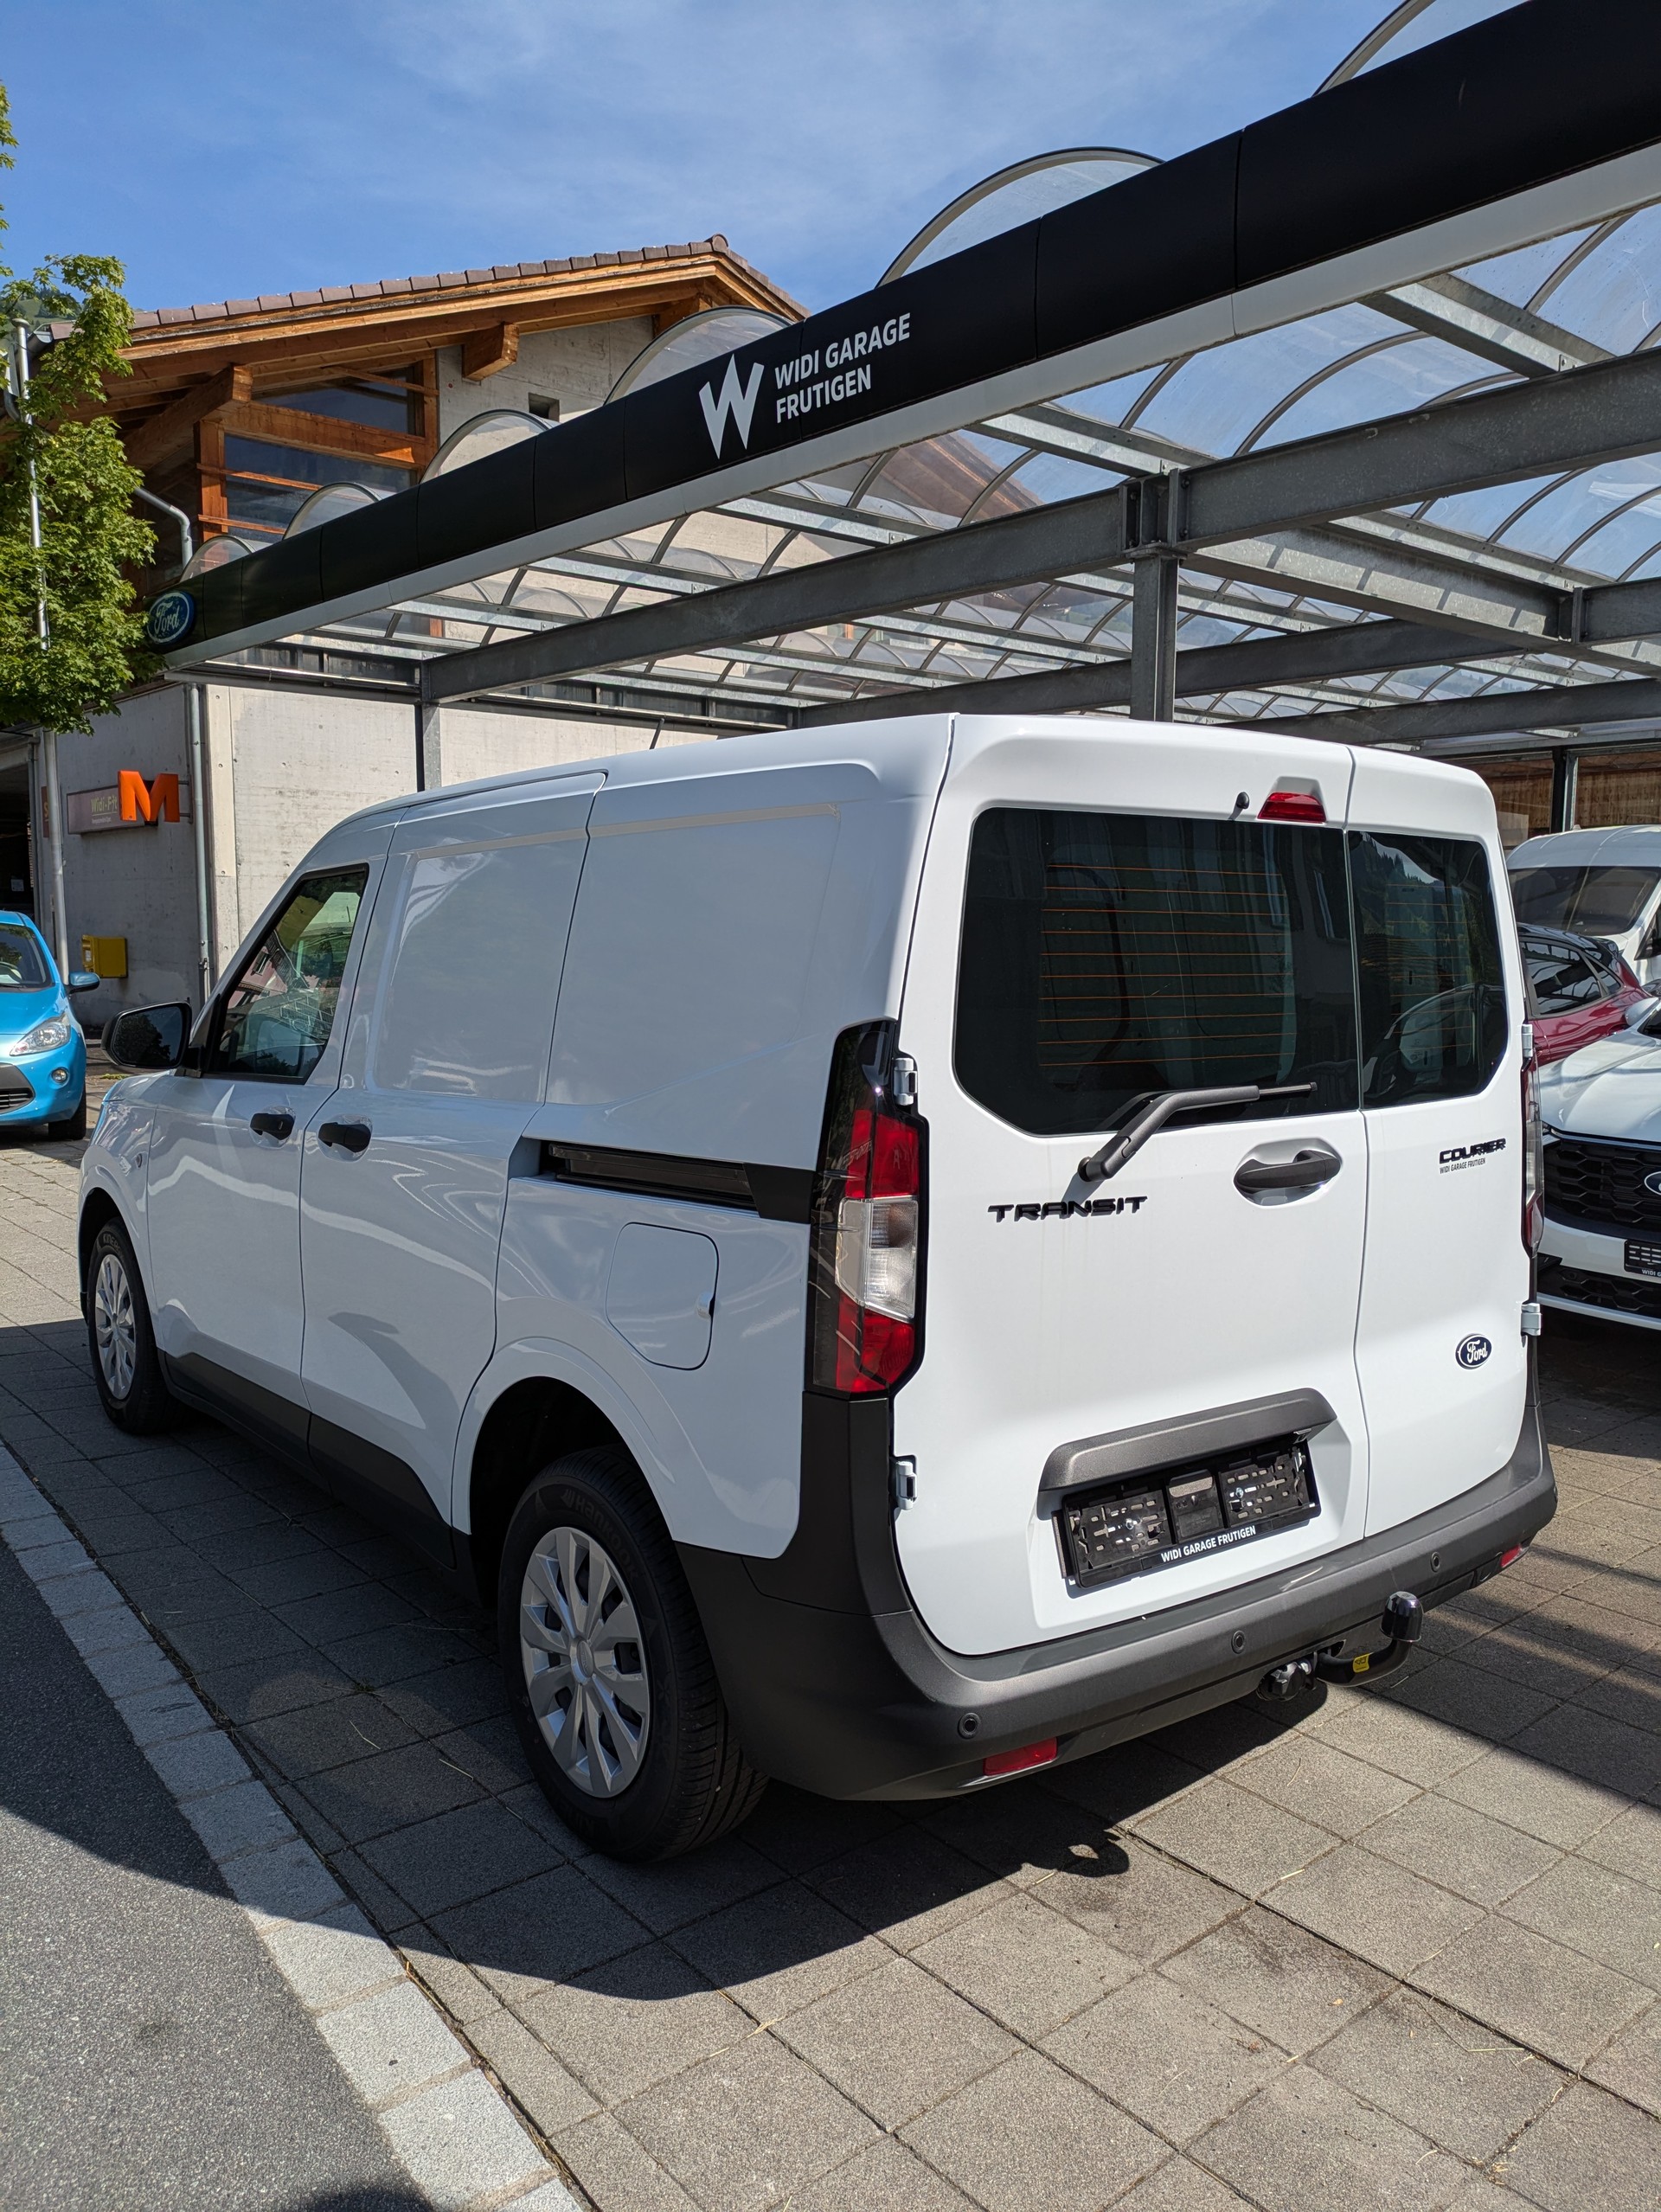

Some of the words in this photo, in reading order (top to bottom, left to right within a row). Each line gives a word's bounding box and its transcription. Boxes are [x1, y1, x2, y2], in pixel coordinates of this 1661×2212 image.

[774, 349, 820, 389] WIDI
[824, 312, 911, 369] GARAGE
[776, 363, 872, 424] FRUTIGEN
[153, 600, 181, 635] Ford
[117, 769, 181, 823] M
[1439, 1138, 1506, 1164] COURIER
[1451, 1162, 1467, 1172] GARAGE
[1467, 1157, 1486, 1168] FRUTIGEN
[987, 1196, 1148, 1222] TRANSIT
[1466, 1339, 1488, 1363] Ford
[1160, 1548, 1182, 1562] WIDI
[1183, 1537, 1217, 1555] GARAGE
[1217, 1526, 1256, 1545] FRUTIGEN
